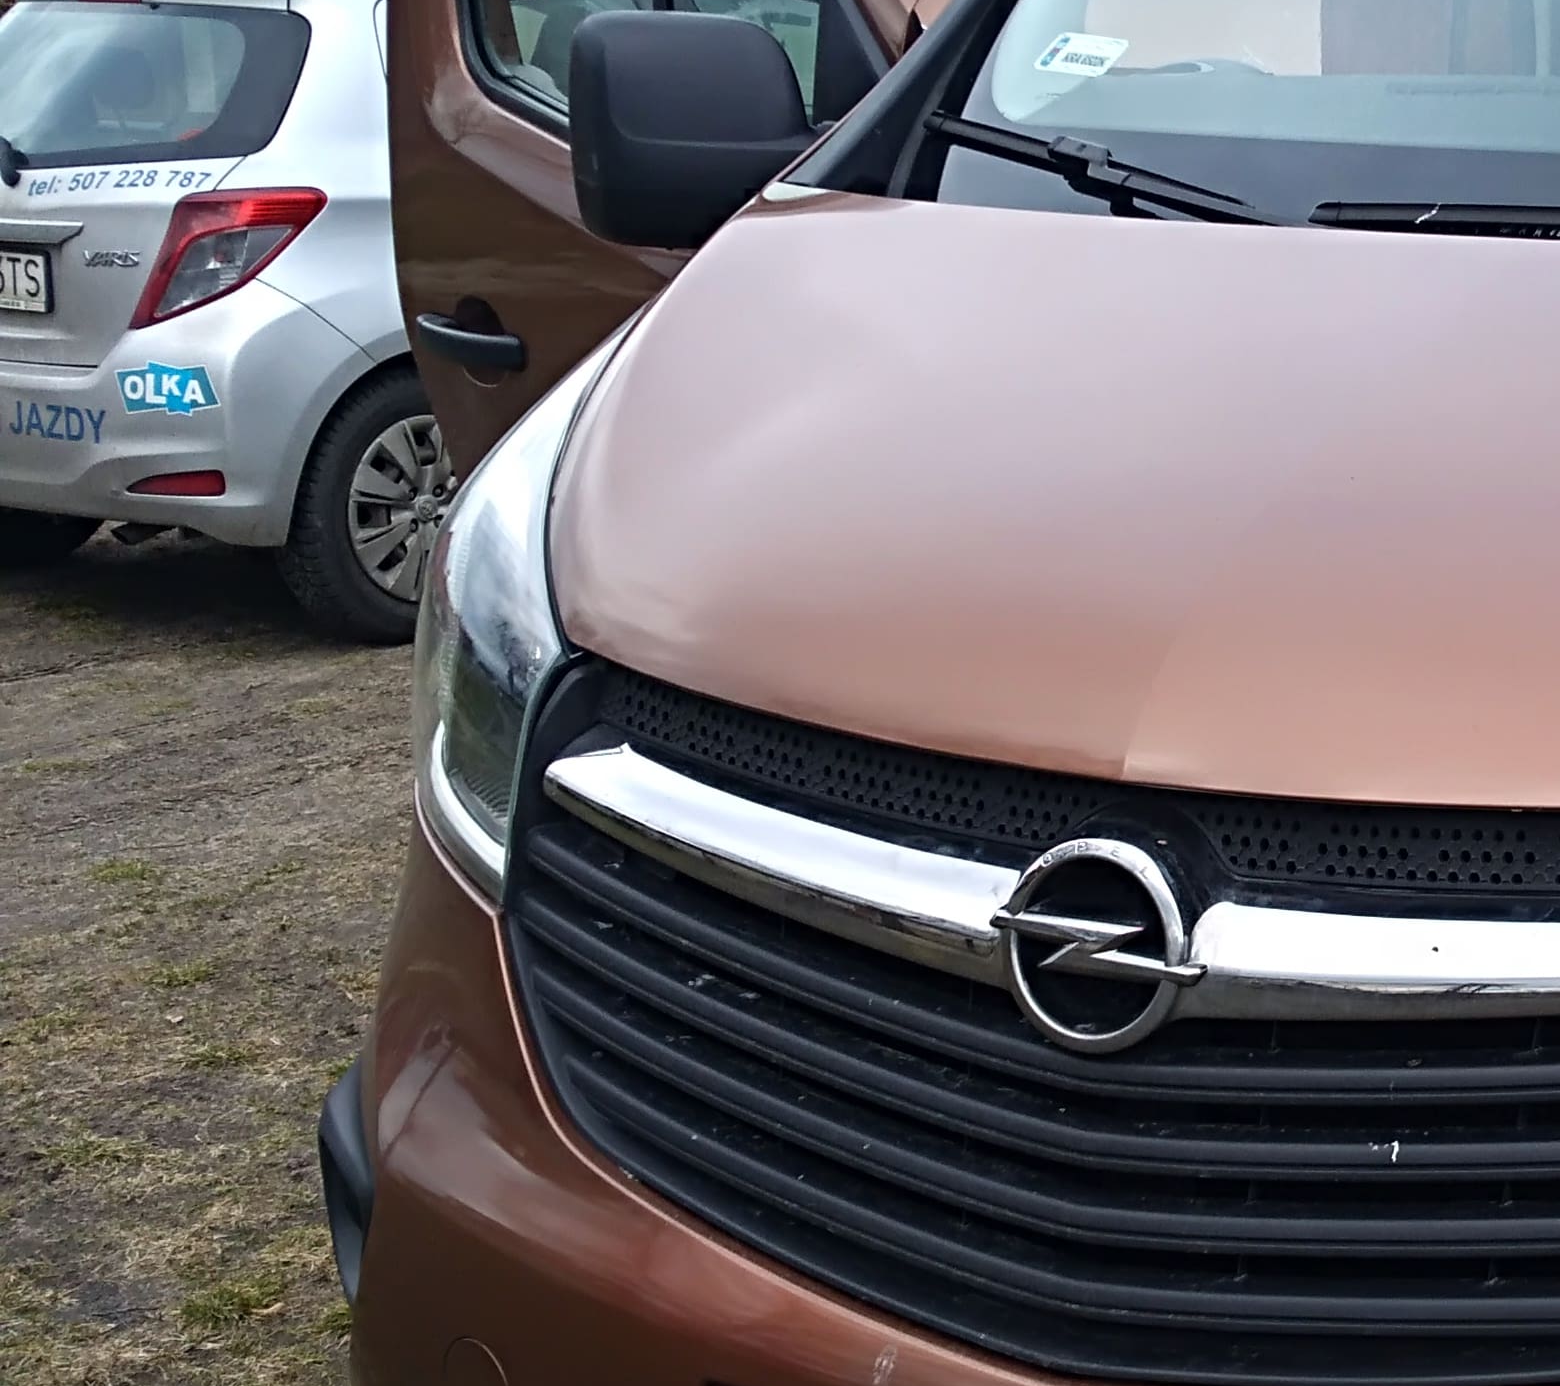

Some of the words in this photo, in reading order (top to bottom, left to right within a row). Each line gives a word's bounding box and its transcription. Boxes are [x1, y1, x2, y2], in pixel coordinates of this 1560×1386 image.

[28, 176, 62, 197] tel:
[68, 170, 110, 192] 507
[113, 169, 159, 189] 228
[165, 170, 211, 189] 787
[83, 249, 141, 267] YARIS
[123, 372, 206, 405] OLKA
[9, 400, 106, 444] JAZDY
[1040, 841, 1150, 880] OPEL
